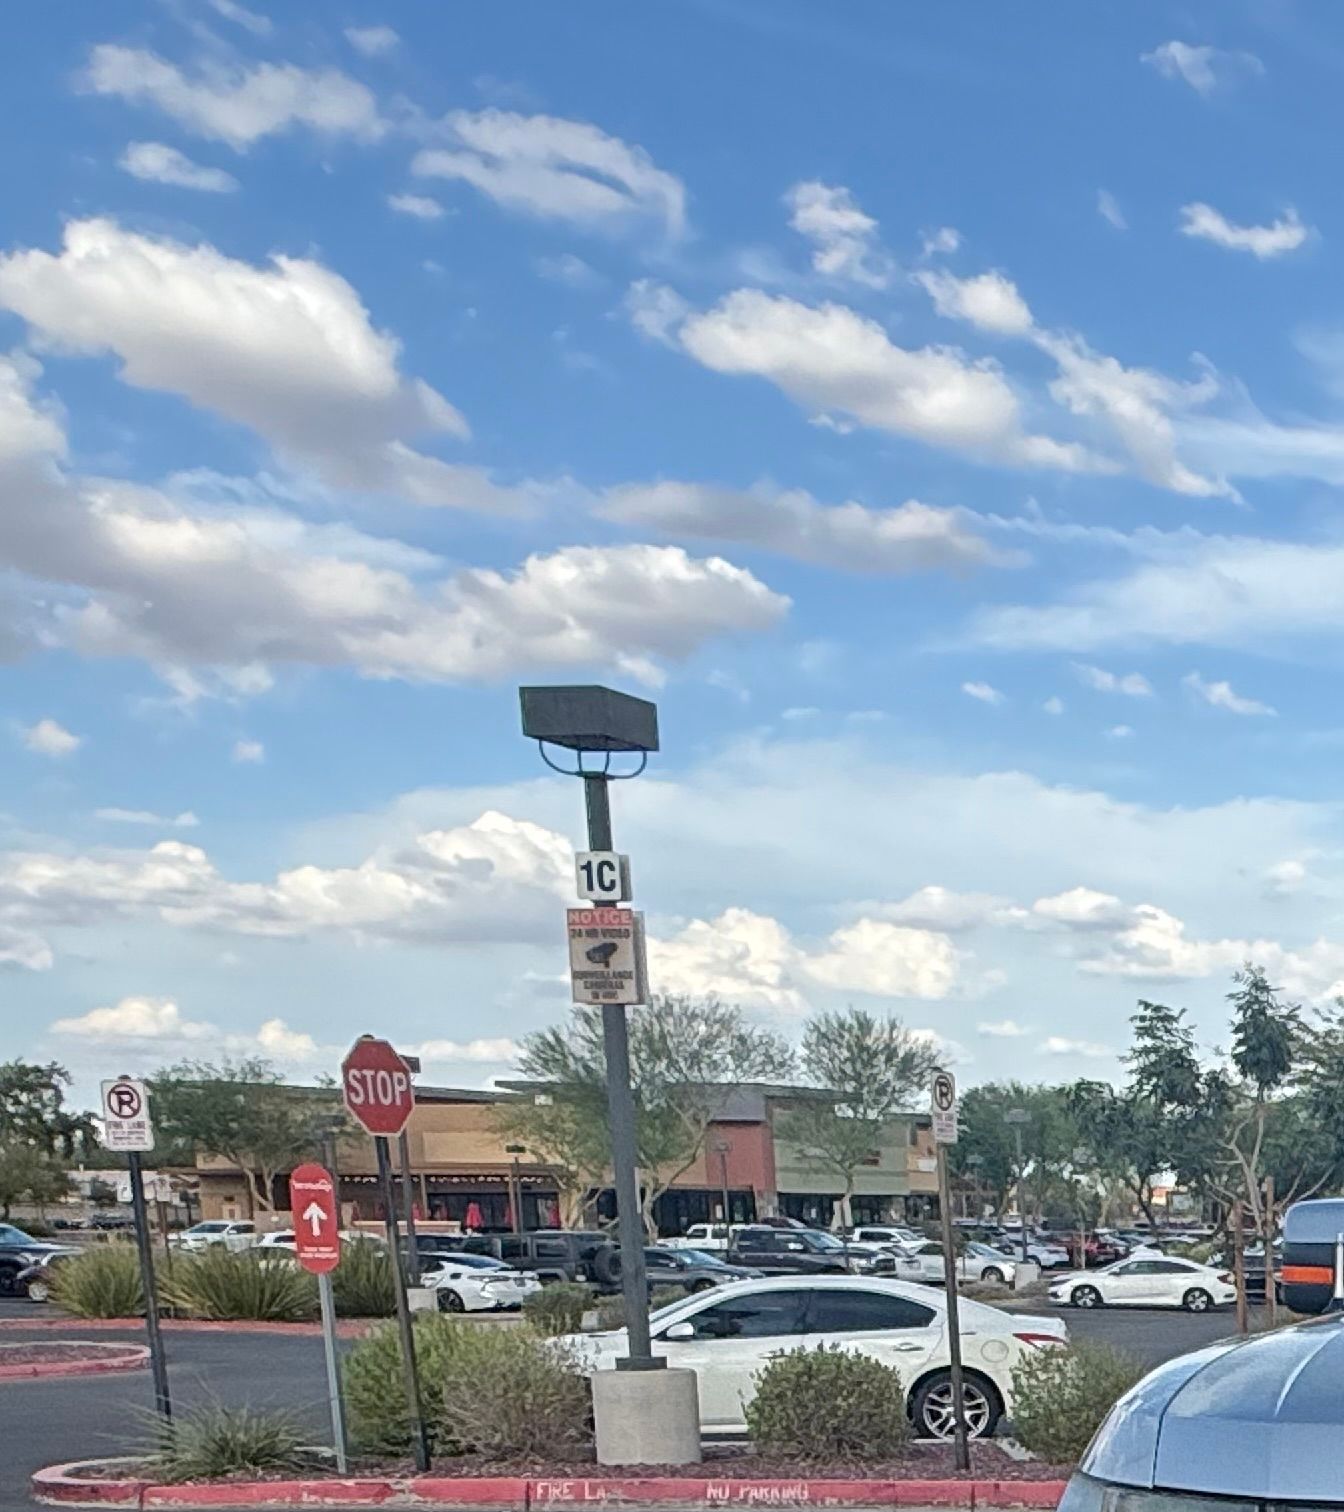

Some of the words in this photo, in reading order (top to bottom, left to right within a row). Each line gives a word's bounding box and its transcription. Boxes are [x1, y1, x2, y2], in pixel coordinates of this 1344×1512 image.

[580, 860, 616, 892] 1C
[569, 910, 631, 924] NOTICE
[348, 1068, 408, 1106] STOP
[536, 1482, 575, 1500] FIRE
[706, 1482, 730, 1499] NO
